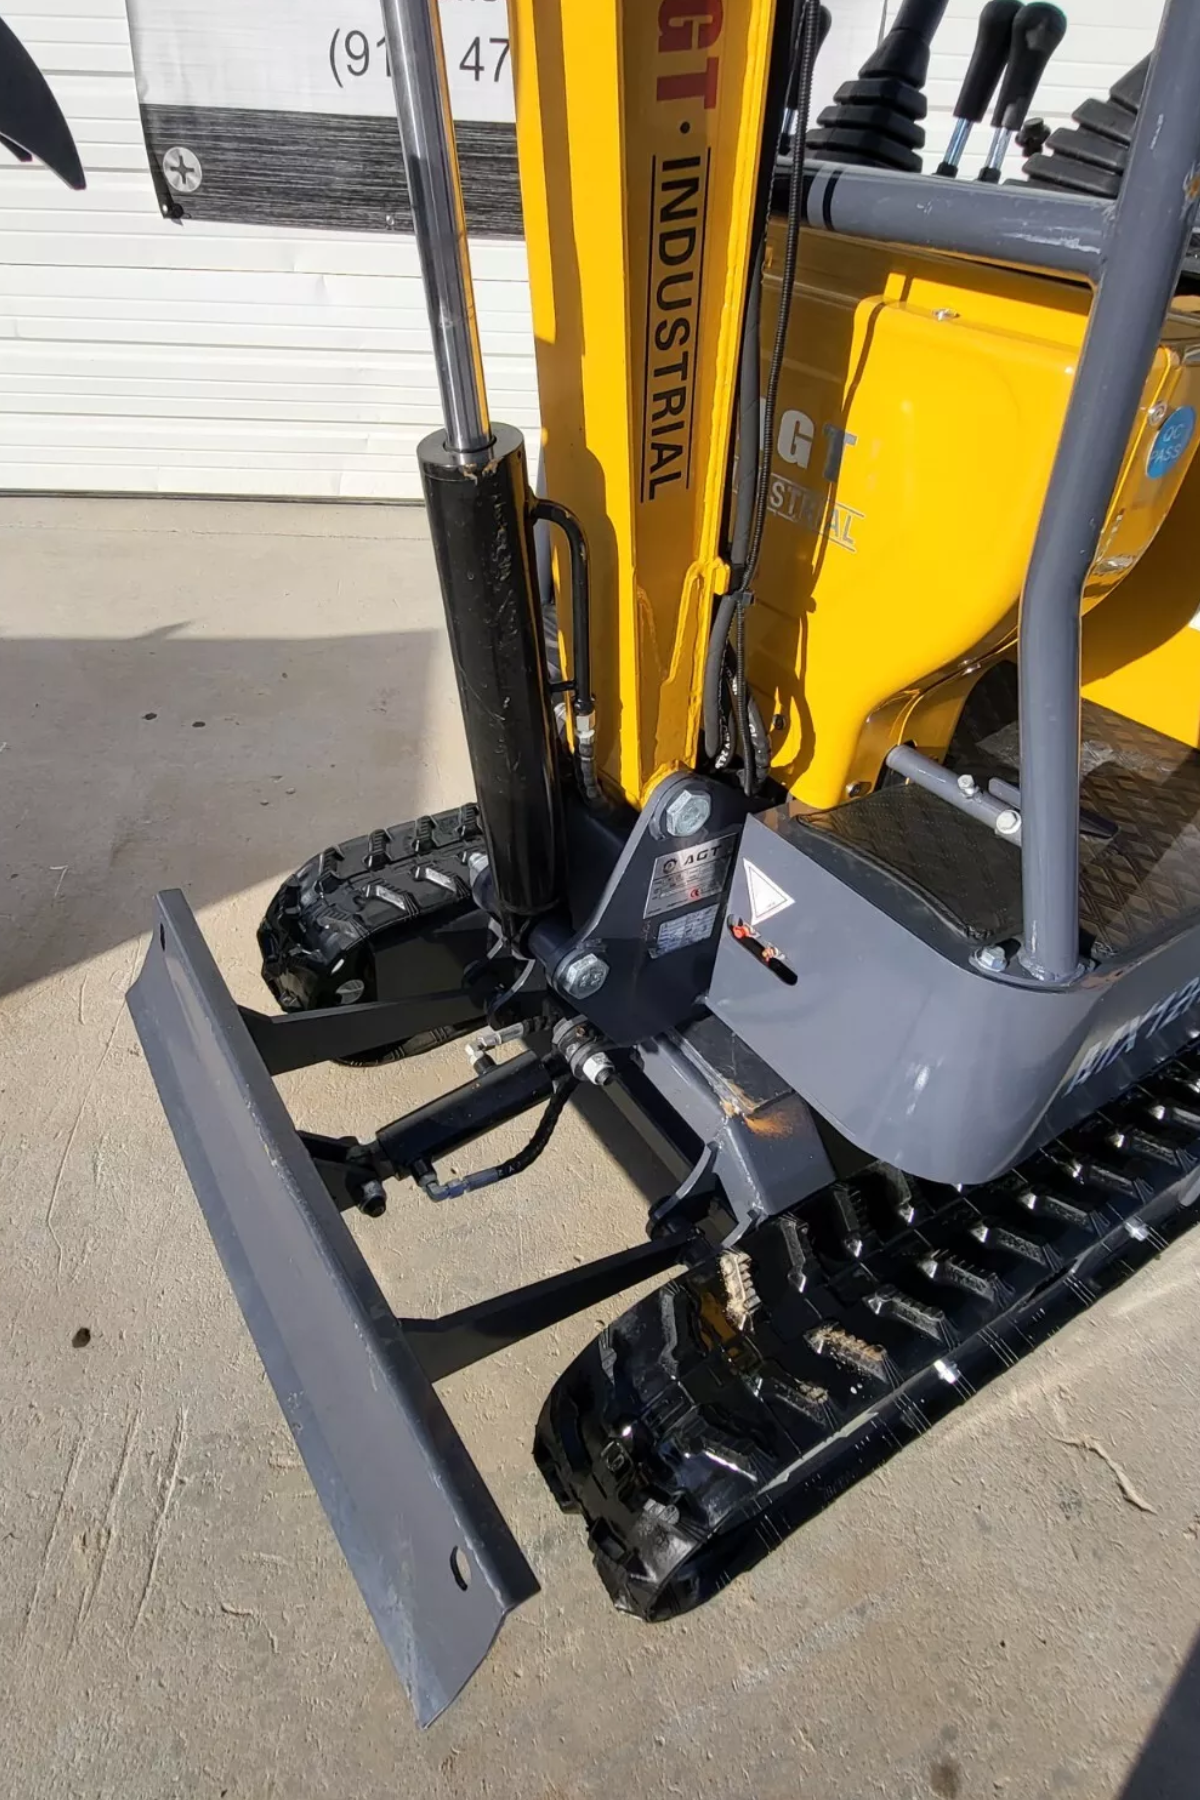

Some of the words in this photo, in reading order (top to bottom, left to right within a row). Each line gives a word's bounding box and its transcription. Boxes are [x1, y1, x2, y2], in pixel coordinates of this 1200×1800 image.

[650, 155, 700, 500] INDUSTRIAL
[760, 398, 858, 484] GT
[683, 845, 723, 867] AGT
